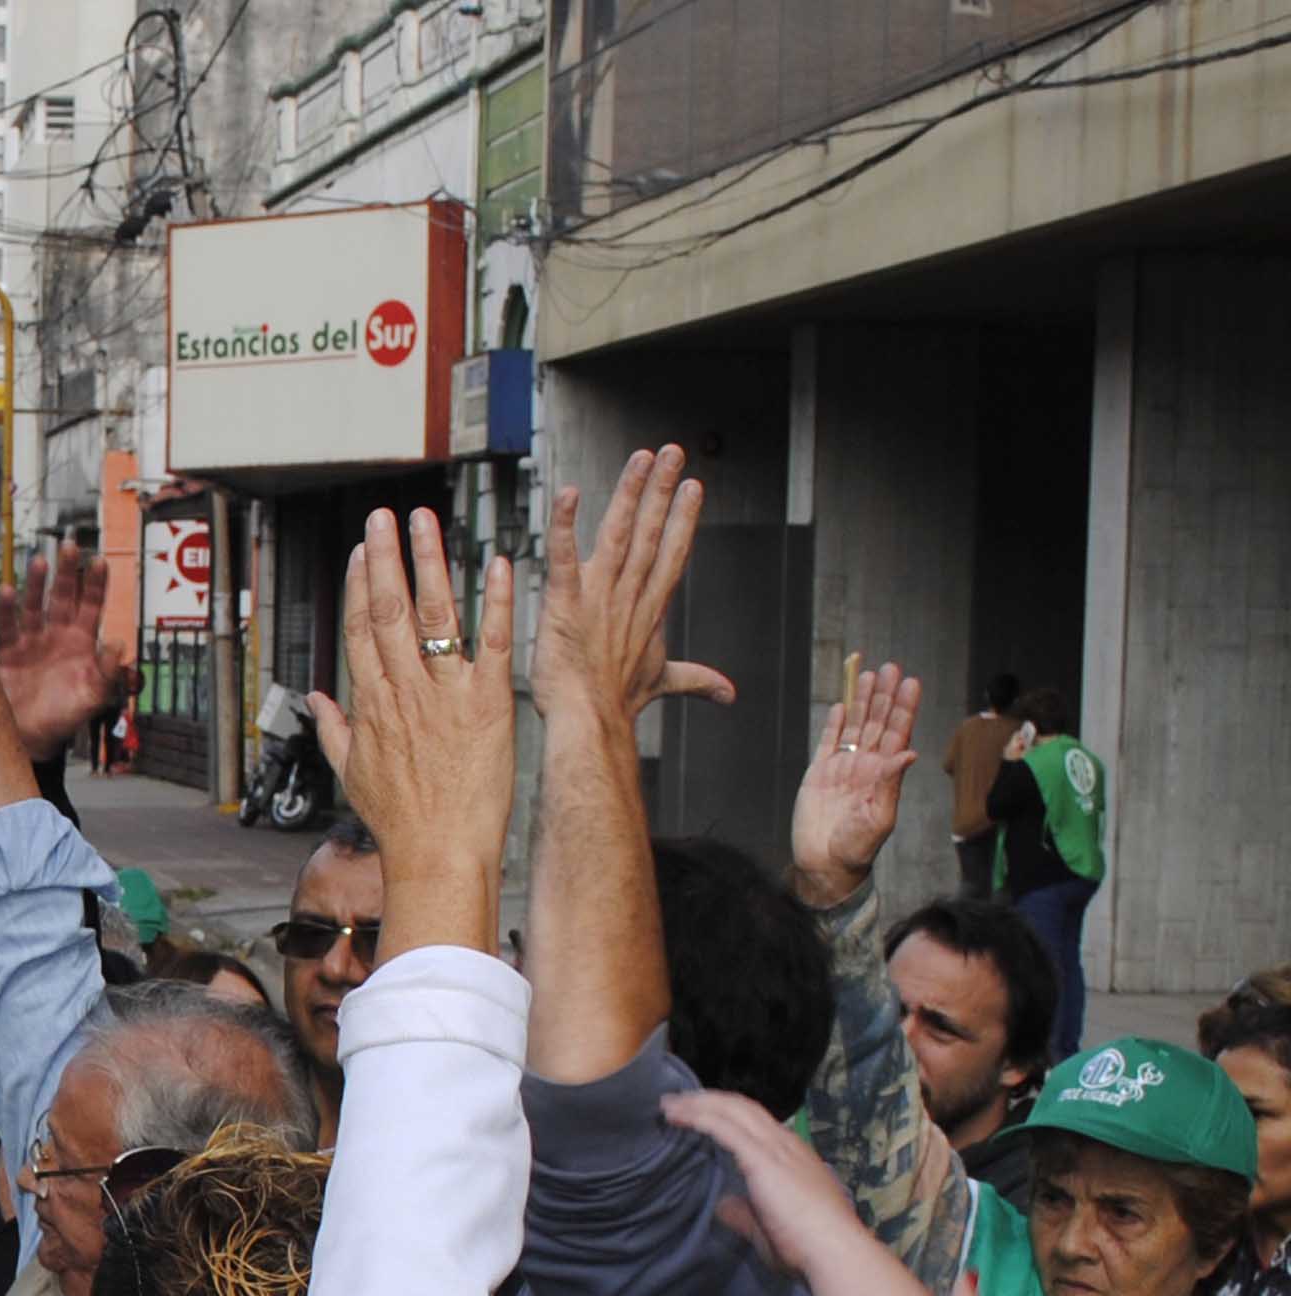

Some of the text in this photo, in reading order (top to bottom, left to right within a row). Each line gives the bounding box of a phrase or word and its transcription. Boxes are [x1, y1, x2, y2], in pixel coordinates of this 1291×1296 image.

[176, 314, 416, 361] Estancias del Sur
